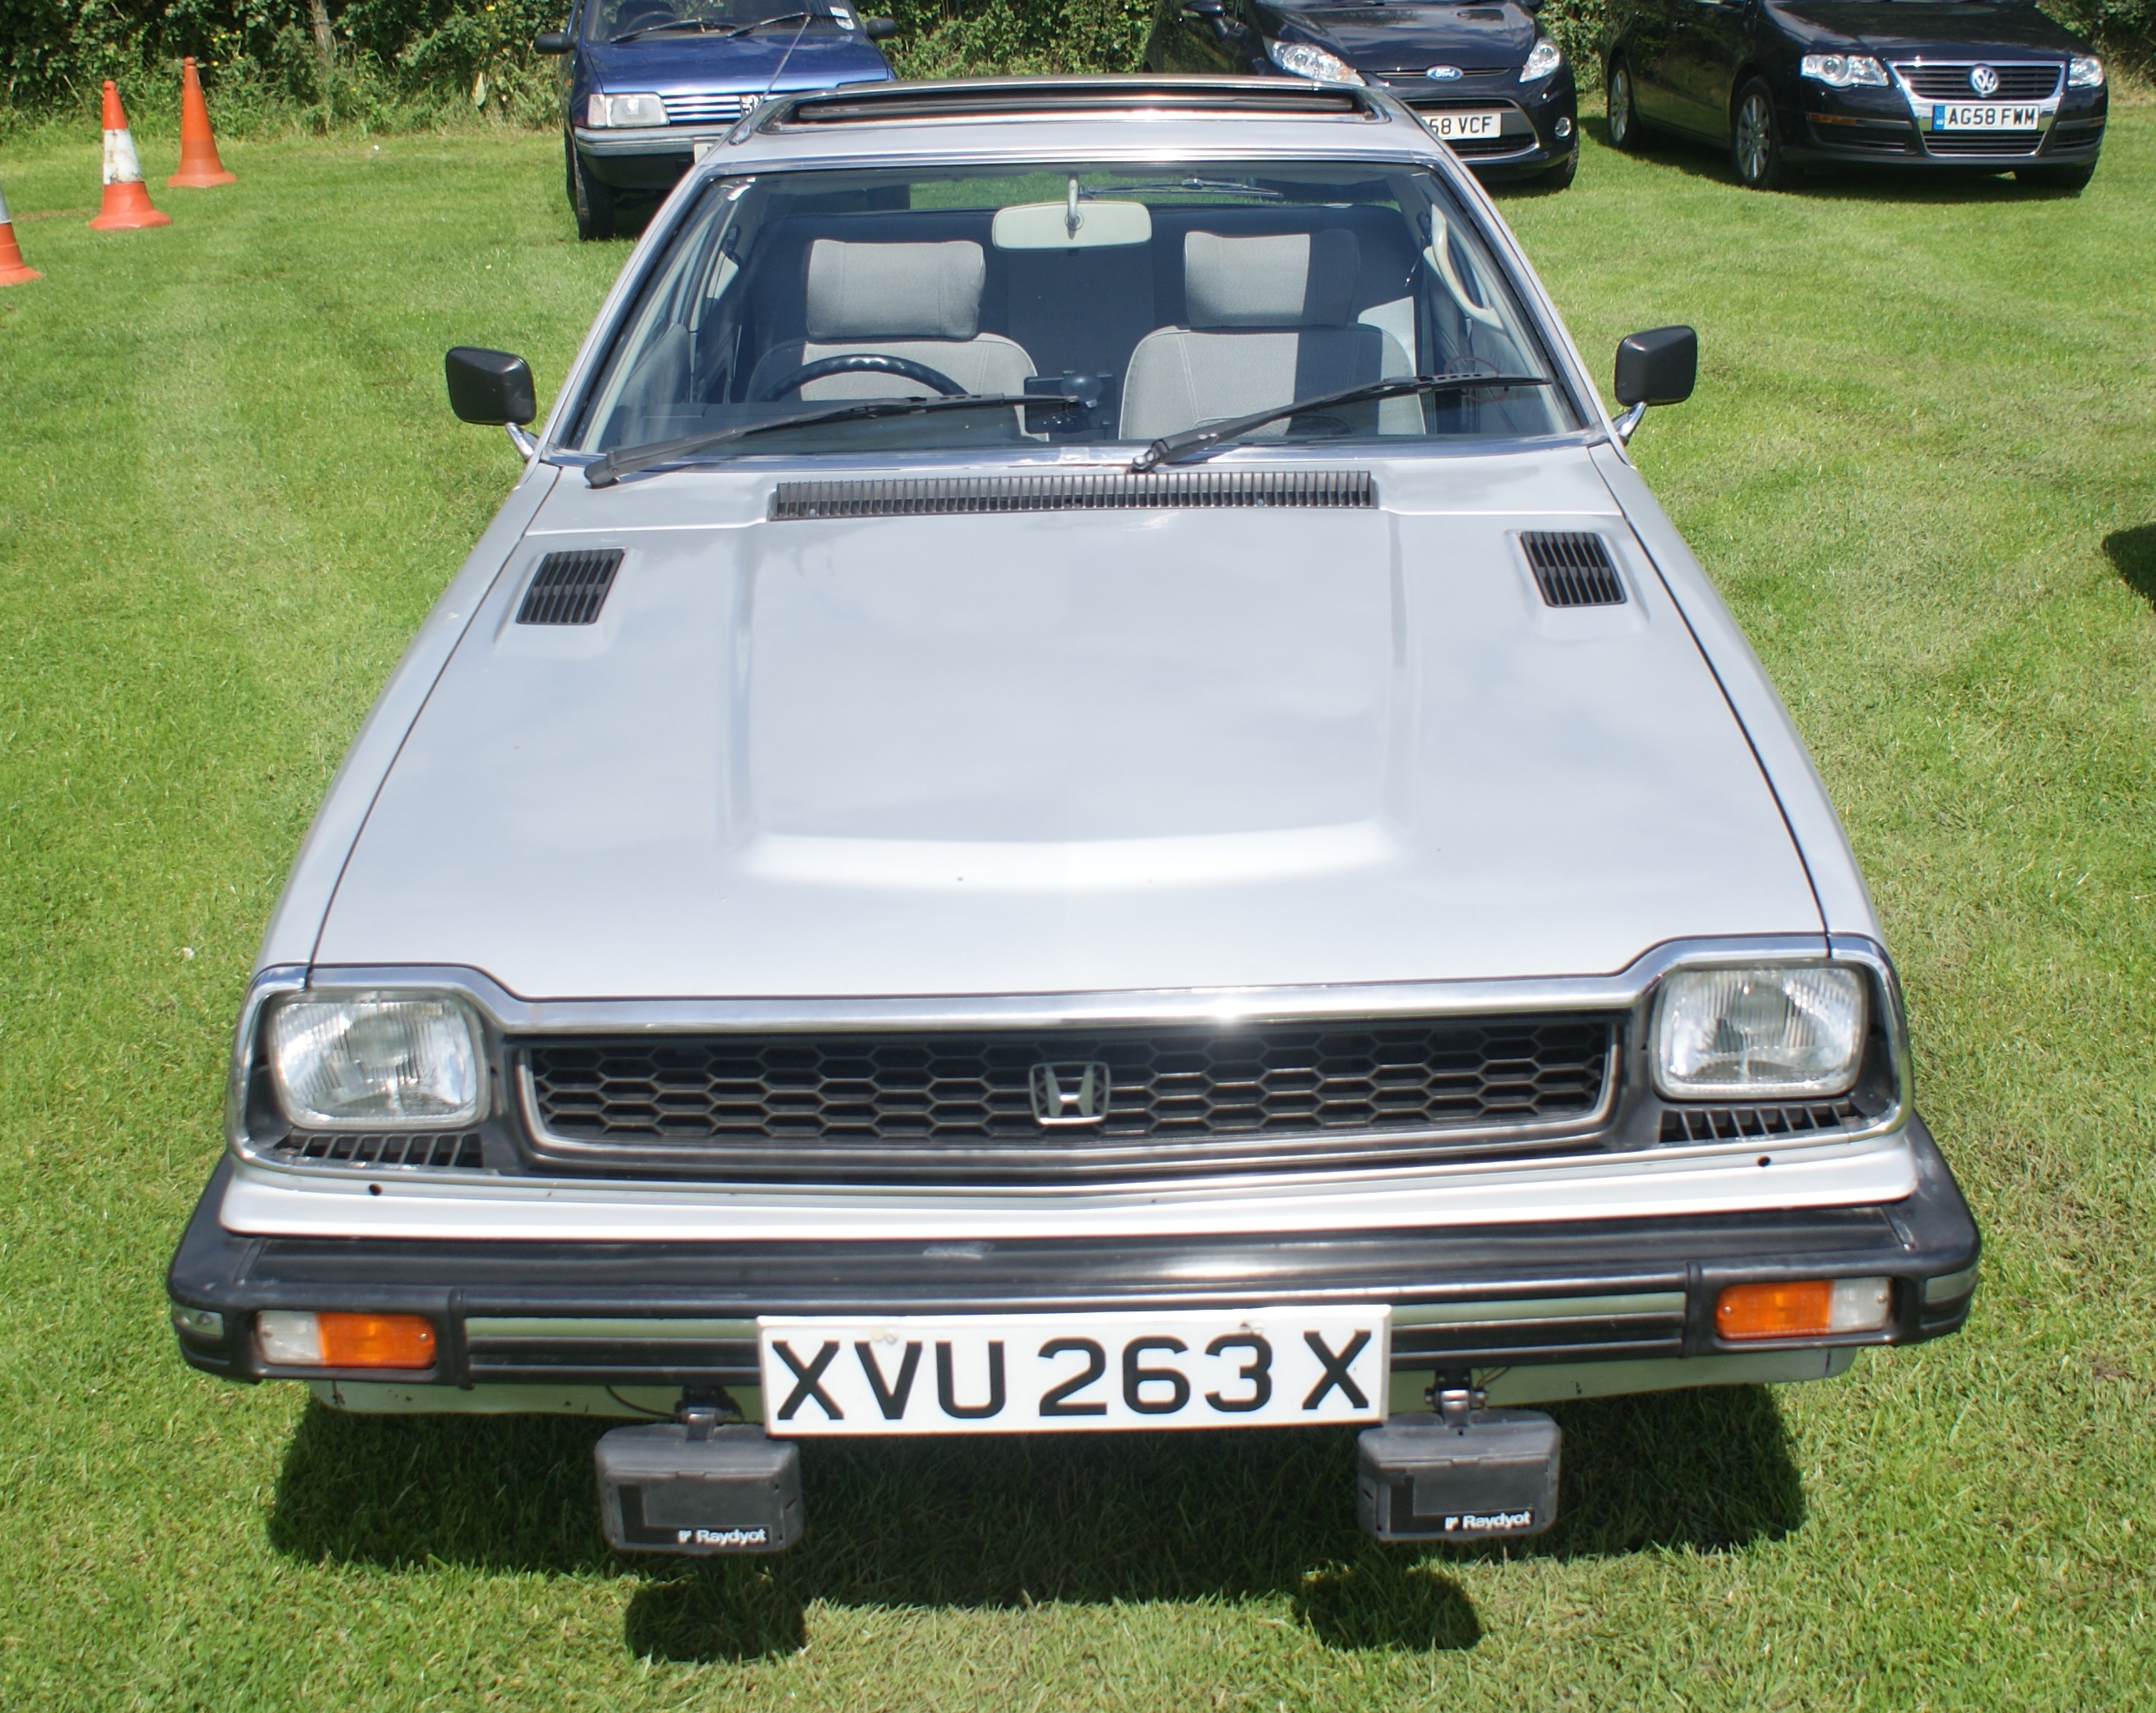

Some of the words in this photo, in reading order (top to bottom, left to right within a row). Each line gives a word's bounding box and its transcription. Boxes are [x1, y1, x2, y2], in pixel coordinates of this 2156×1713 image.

[1458, 116, 1492, 134] VCF
[1948, 108, 1996, 125] AG58
[2001, 108, 2036, 125] FWM
[772, 1342, 1006, 1421] XVU
[1038, 1333, 1273, 1417] 263
[1302, 1331, 1371, 1410] X
[1462, 1510, 1531, 1531] Raydyot
[696, 1528, 767, 1548] Raydyot
